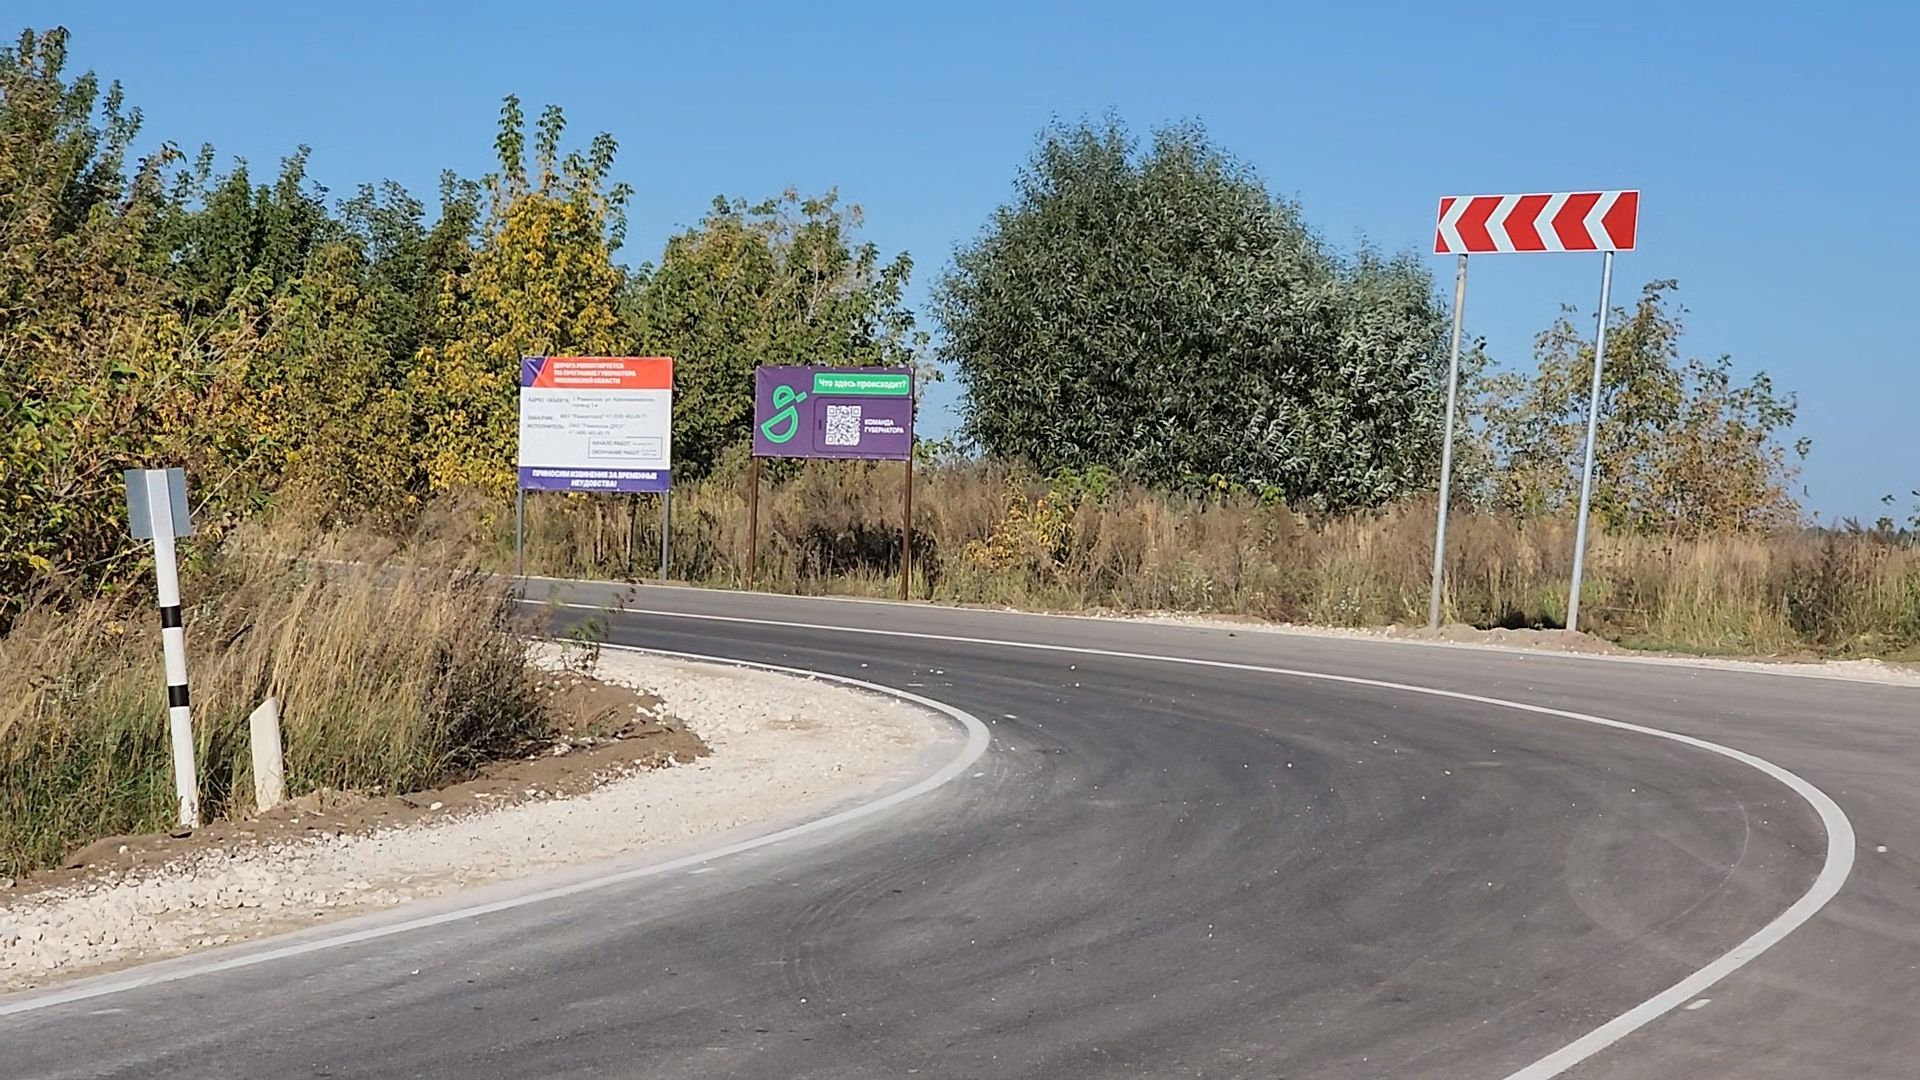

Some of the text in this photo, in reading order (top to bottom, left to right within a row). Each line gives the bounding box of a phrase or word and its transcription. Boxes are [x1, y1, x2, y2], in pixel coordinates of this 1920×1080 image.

[818, 378, 907, 389] Что здесь происходит?
[864, 418, 894, 426] КОМАНДА
[864, 426, 904, 434] ГУБЕРНАТОРА
[532, 469, 569, 477] ПРИНОСИМ
[570, 470, 608, 478] ИЗВИНЕНИЯ
[618, 471, 657, 479] ВРЕМЕННЫЕ
[571, 479, 617, 488] НЕУДОБСТВА!
